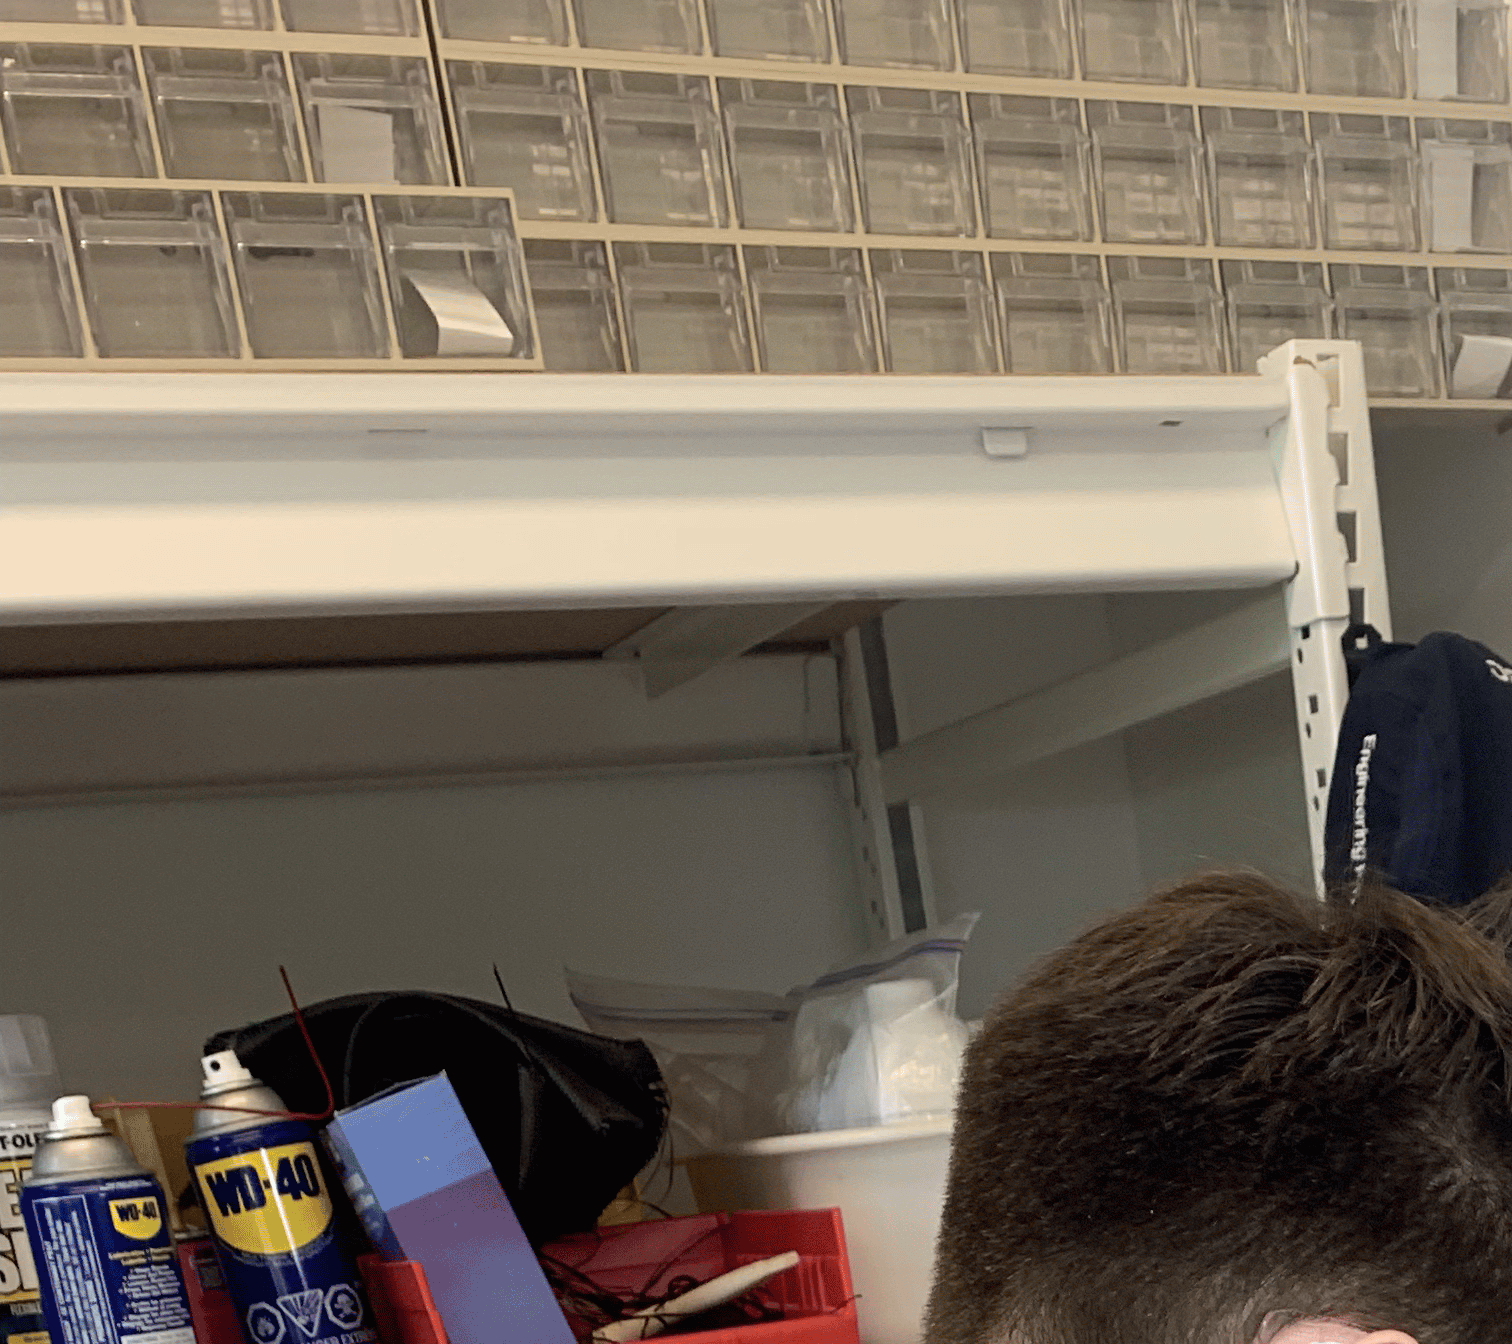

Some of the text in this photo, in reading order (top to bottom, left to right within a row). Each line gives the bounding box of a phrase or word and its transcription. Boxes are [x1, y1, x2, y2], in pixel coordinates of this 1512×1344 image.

[1351, 734, 1377, 861] Engineering
[115, 1201, 157, 1222] WD-40
[204, 1154, 320, 1217] WD-40
